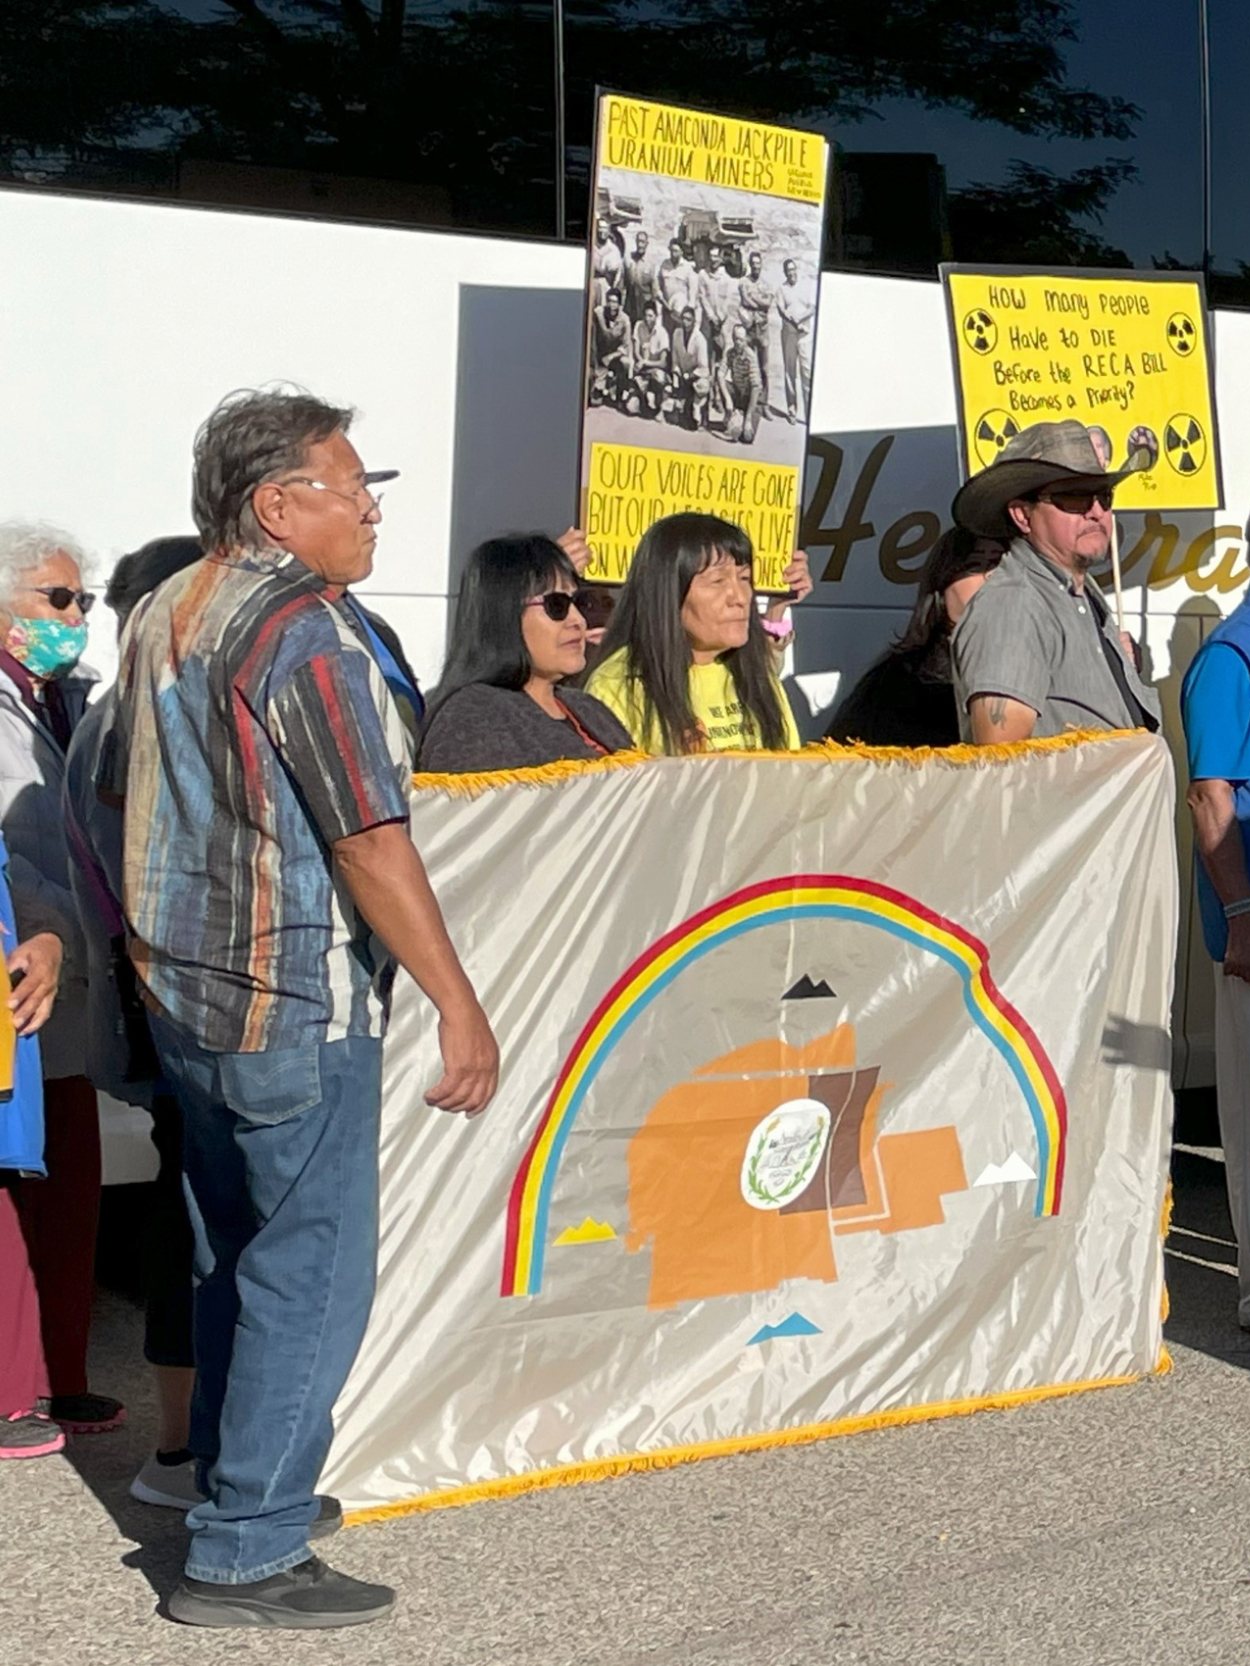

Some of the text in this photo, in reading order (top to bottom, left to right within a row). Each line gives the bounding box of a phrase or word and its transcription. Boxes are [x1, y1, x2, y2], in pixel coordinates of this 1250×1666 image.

[608, 101, 808, 168] PAST ANACONDA JACKPILE
[608, 135, 775, 191] URANIUM MINERS
[988, 284, 1026, 310] HOW
[1009, 325, 1117, 351] Have to DIE
[993, 352, 1168, 386] Before the RECA BILL
[1009, 380, 1135, 412] Becomes a Priority?
[657, 458, 716, 500] VOICES
[718, 467, 748, 505] ARE
[753, 470, 796, 510] GONE
[589, 491, 624, 536] BUT
[756, 511, 793, 555] LIVE
[587, 541, 609, 577] ON
